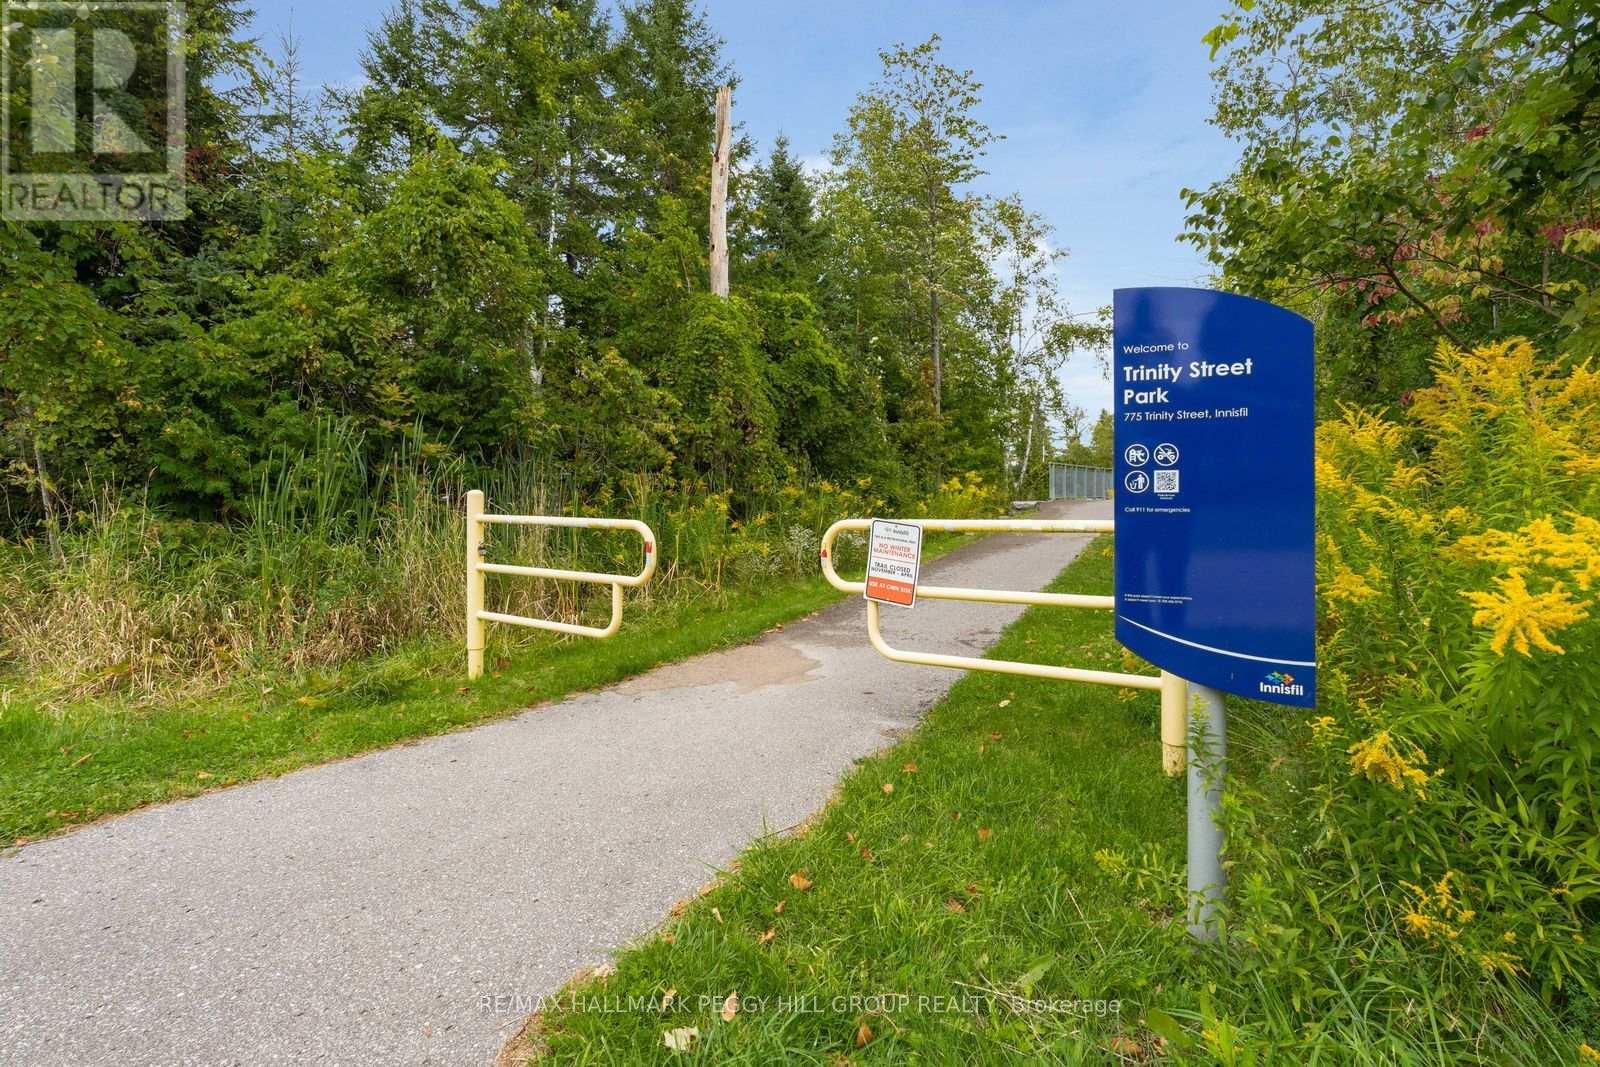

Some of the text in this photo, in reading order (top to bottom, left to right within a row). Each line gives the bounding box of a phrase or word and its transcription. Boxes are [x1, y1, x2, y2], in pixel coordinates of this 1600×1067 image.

[1123, 341, 1189, 354] Welcome to
[1123, 358, 1253, 383] Trinity Street
[1123, 387, 1169, 404] Park
[1124, 407, 1248, 422] 775 Trinity Street, Innisfil
[873, 547, 916, 559] MAINTENANCE
[889, 544, 912, 553] WINTER
[871, 566, 896, 575] NOVEMBER
[874, 561, 911, 573] TRAIL CLOSED
[1259, 681, 1304, 696] Innisfil
